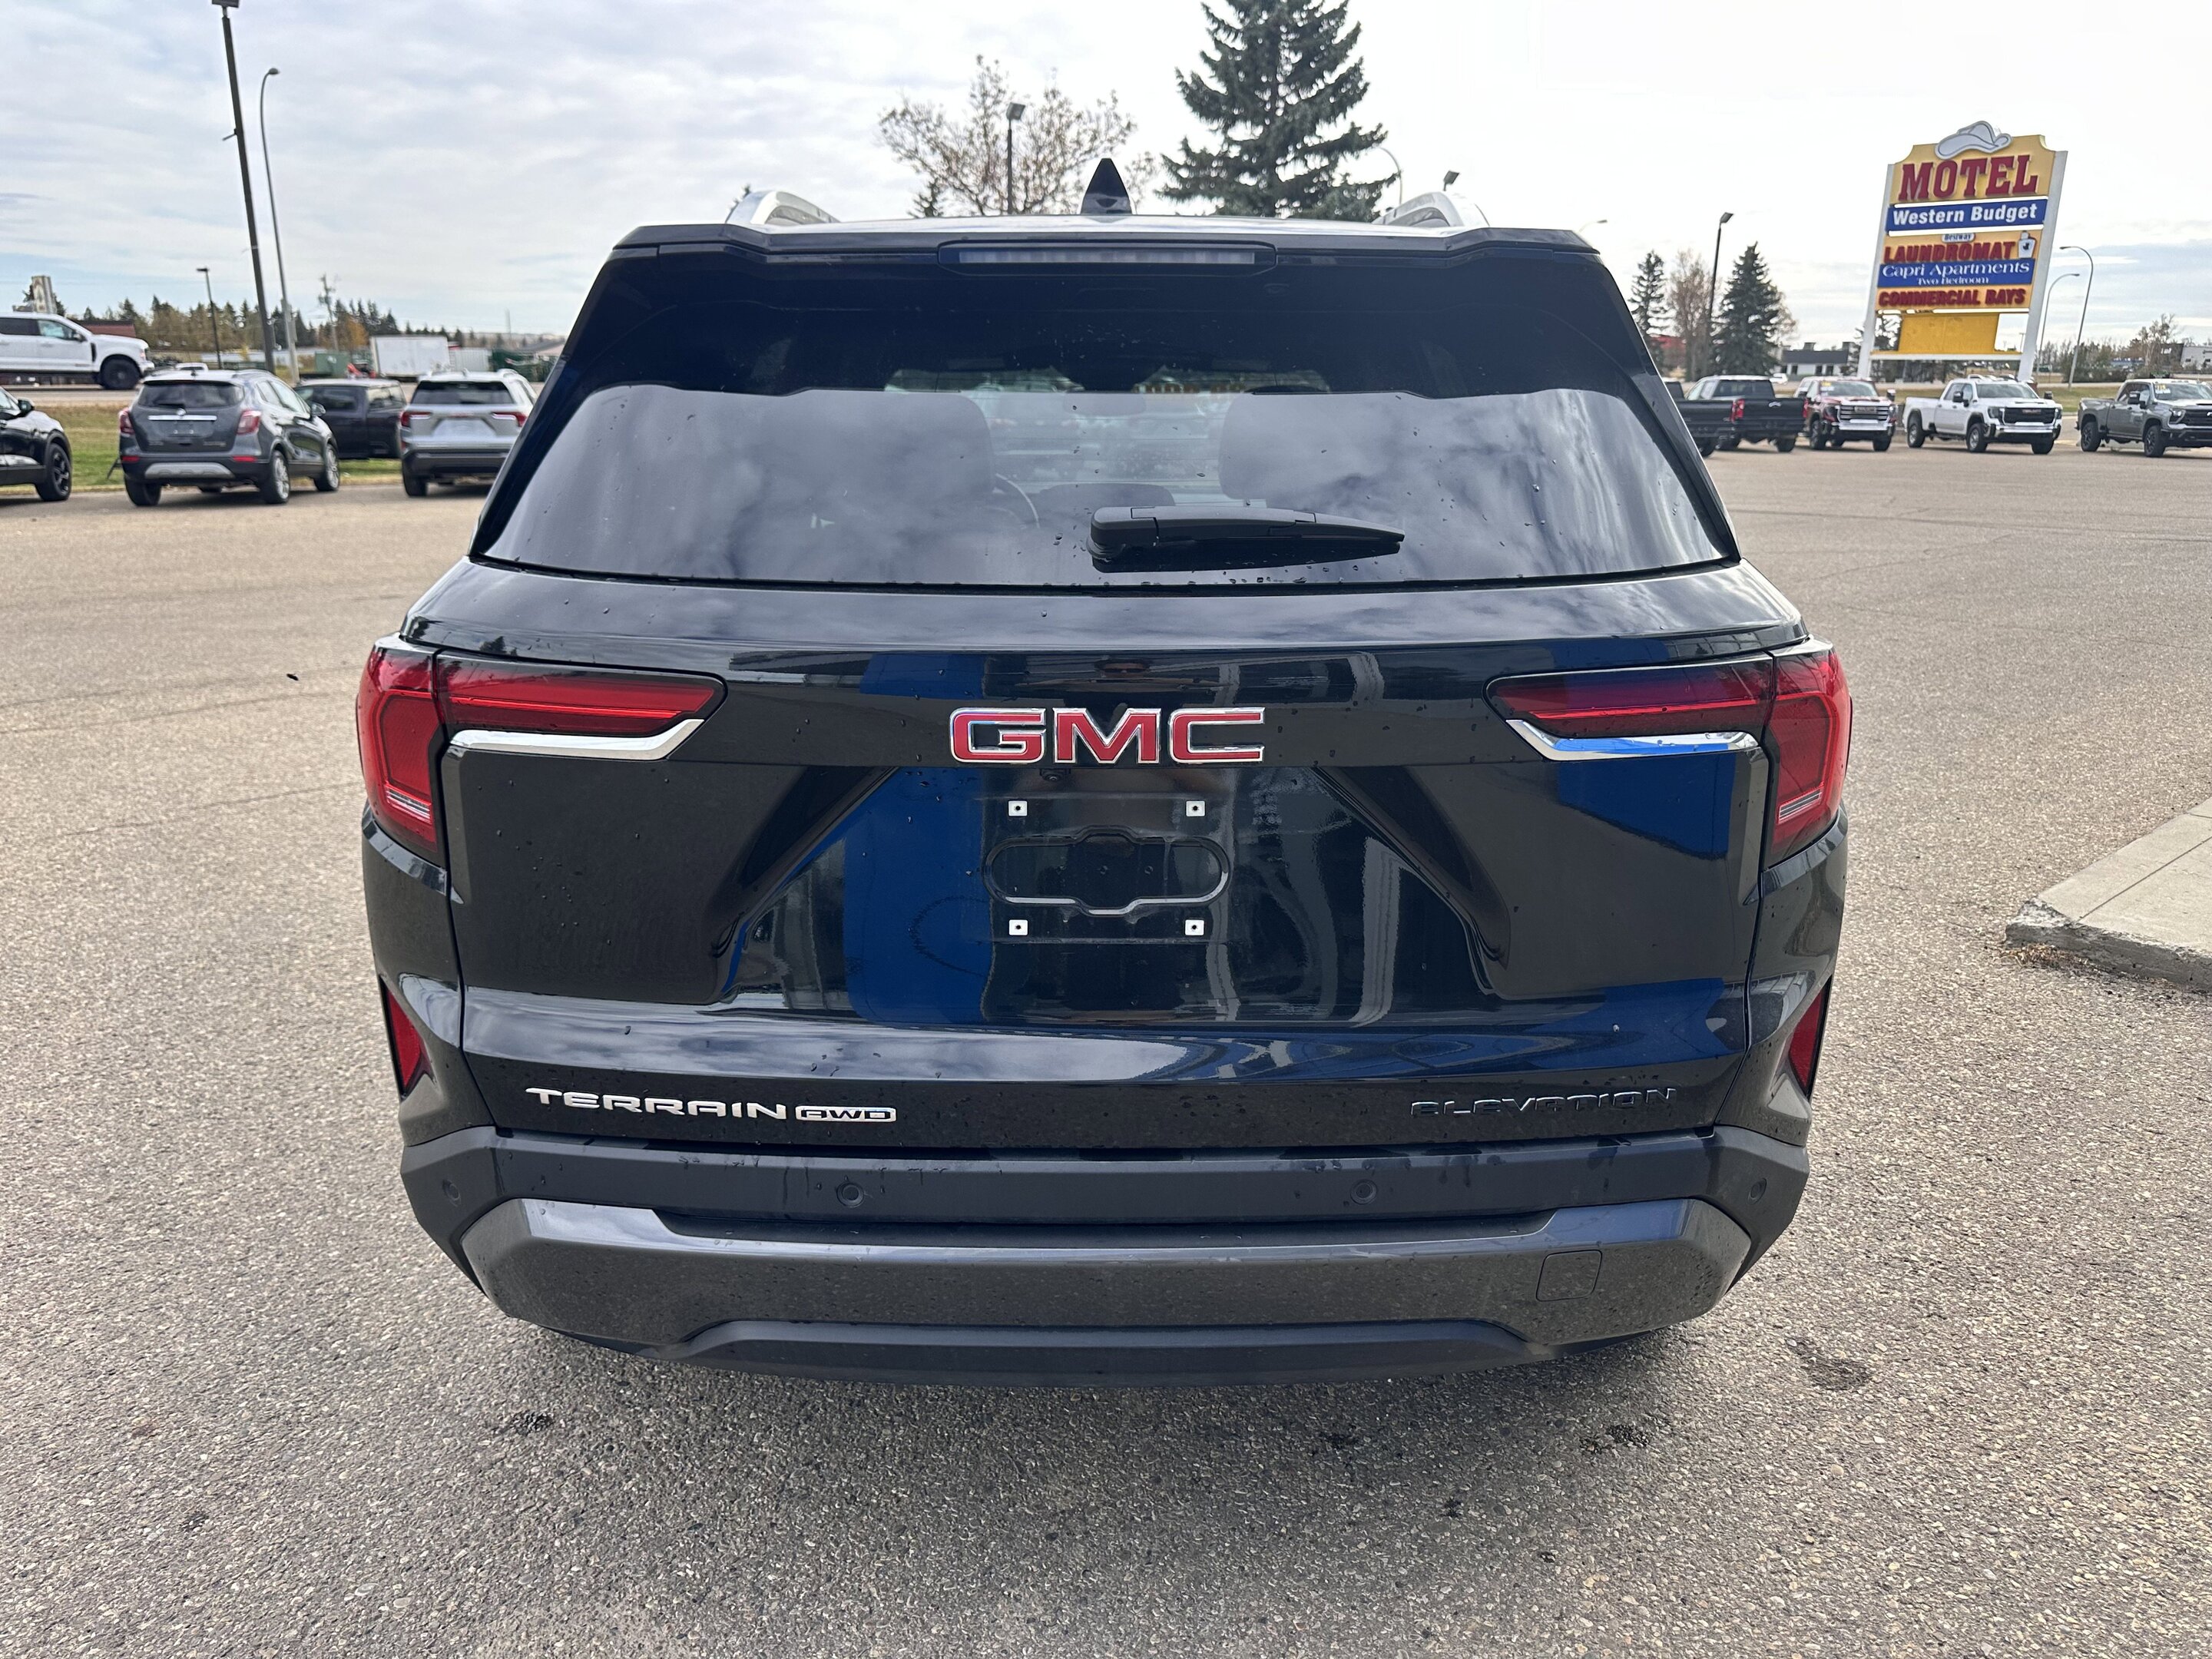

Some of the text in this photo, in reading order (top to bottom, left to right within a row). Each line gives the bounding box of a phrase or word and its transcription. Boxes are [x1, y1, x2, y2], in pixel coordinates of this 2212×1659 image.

[1898, 154, 2038, 202] MOTEL
[1892, 204, 2037, 226] Western Budget
[1884, 240, 2016, 264] LAUNDROMAT
[1883, 261, 2030, 279] Capri Apartments
[1941, 276, 1989, 285] Bedroom
[1878, 288, 2026, 307] COMMERCIAL BAYS
[949, 707, 1265, 763] GMC
[525, 1088, 893, 1121] TERRAIN AWD
[1411, 1088, 1676, 1115] ELEVATION
